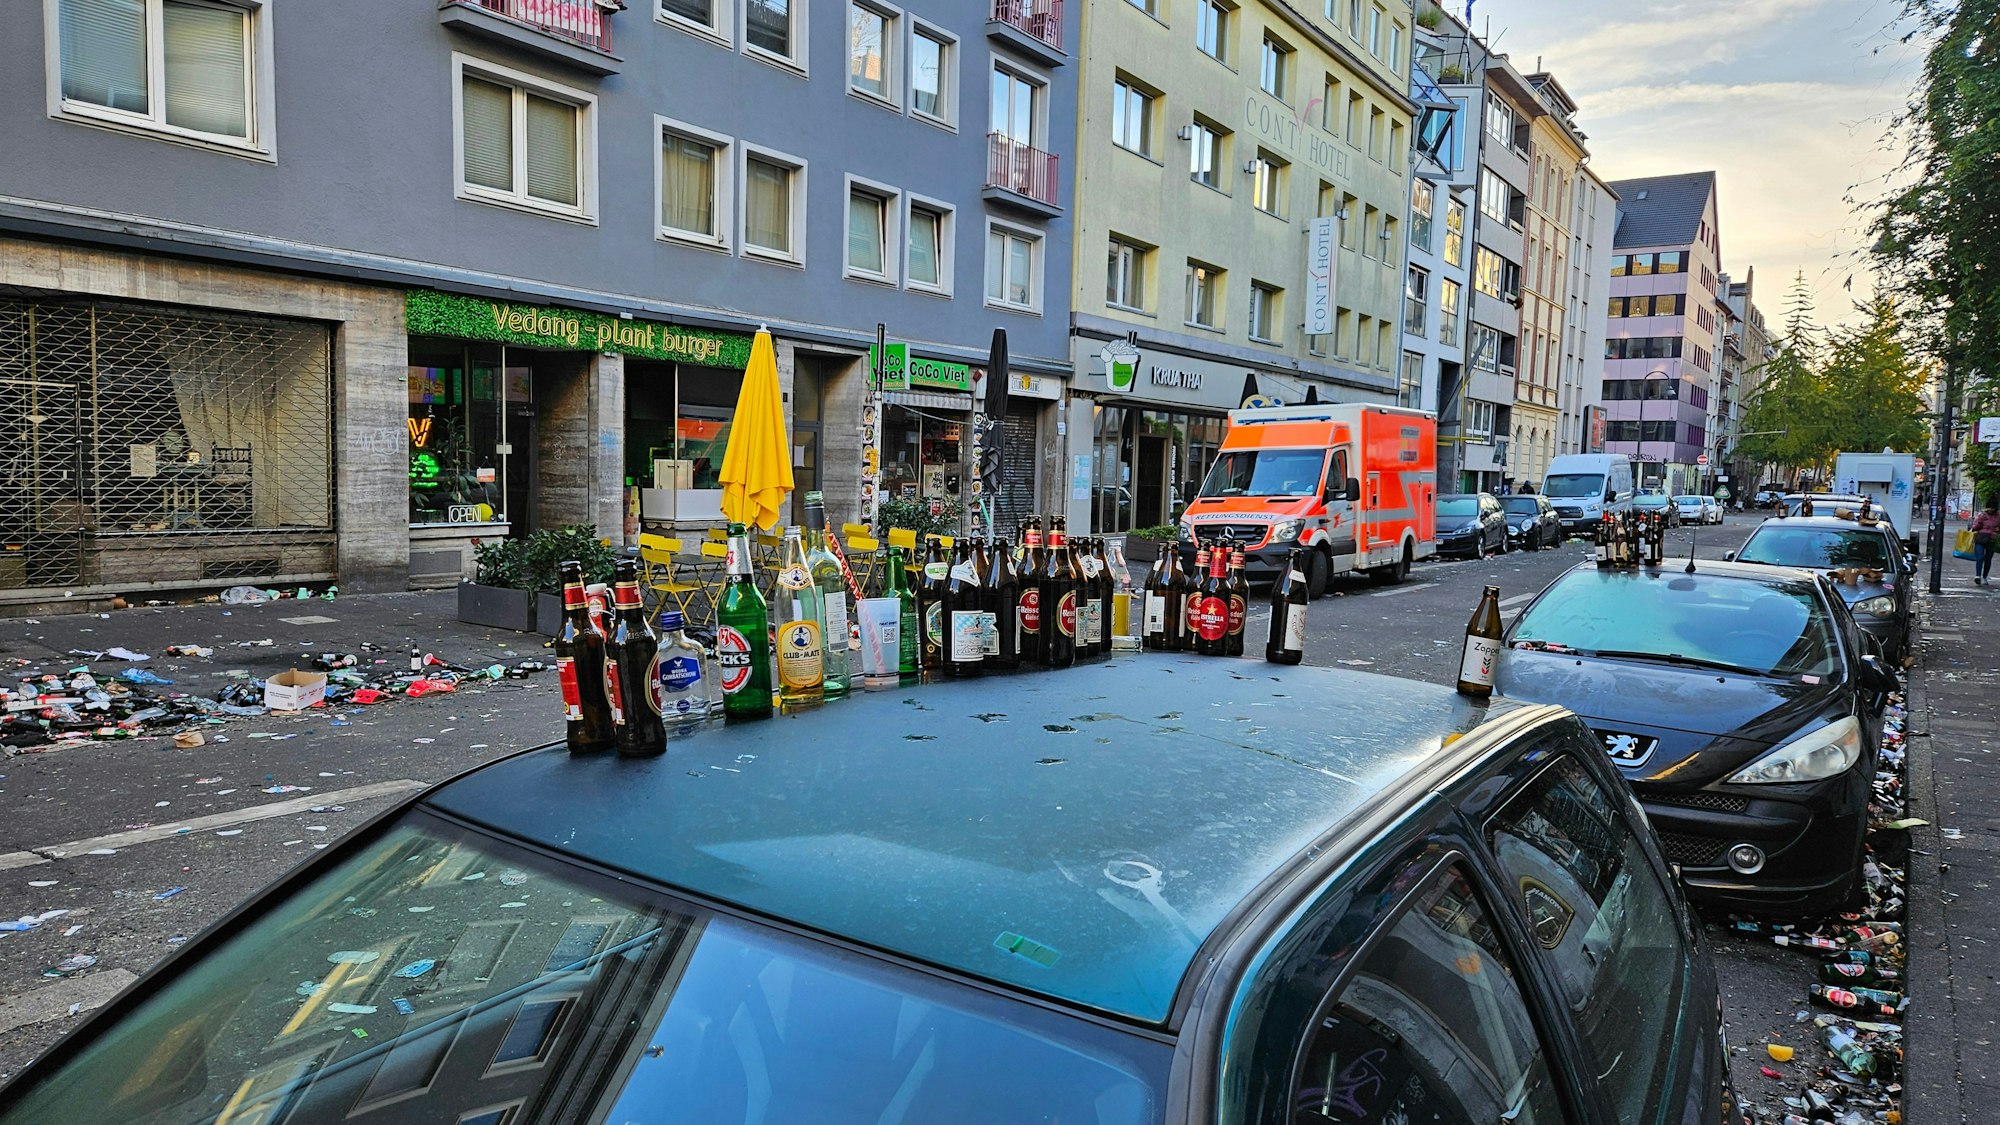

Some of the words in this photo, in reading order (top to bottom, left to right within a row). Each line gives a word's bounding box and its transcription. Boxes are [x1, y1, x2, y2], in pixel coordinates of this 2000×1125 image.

[1309, 133, 1350, 181] HOTEL
[1317, 218, 1331, 268] HOTEL
[492, 303, 579, 345] Vedang
[598, 319, 655, 348] plant
[663, 326, 723, 360] burger
[909, 361, 939, 379] CoCo
[943, 366, 965, 382] Viet
[1152, 365, 1181, 387] KRUA
[450, 507, 481, 523] OPEN
[1195, 512, 1275, 521] RETTUNGSDIENST
[720, 652, 751, 665] ECK'S
